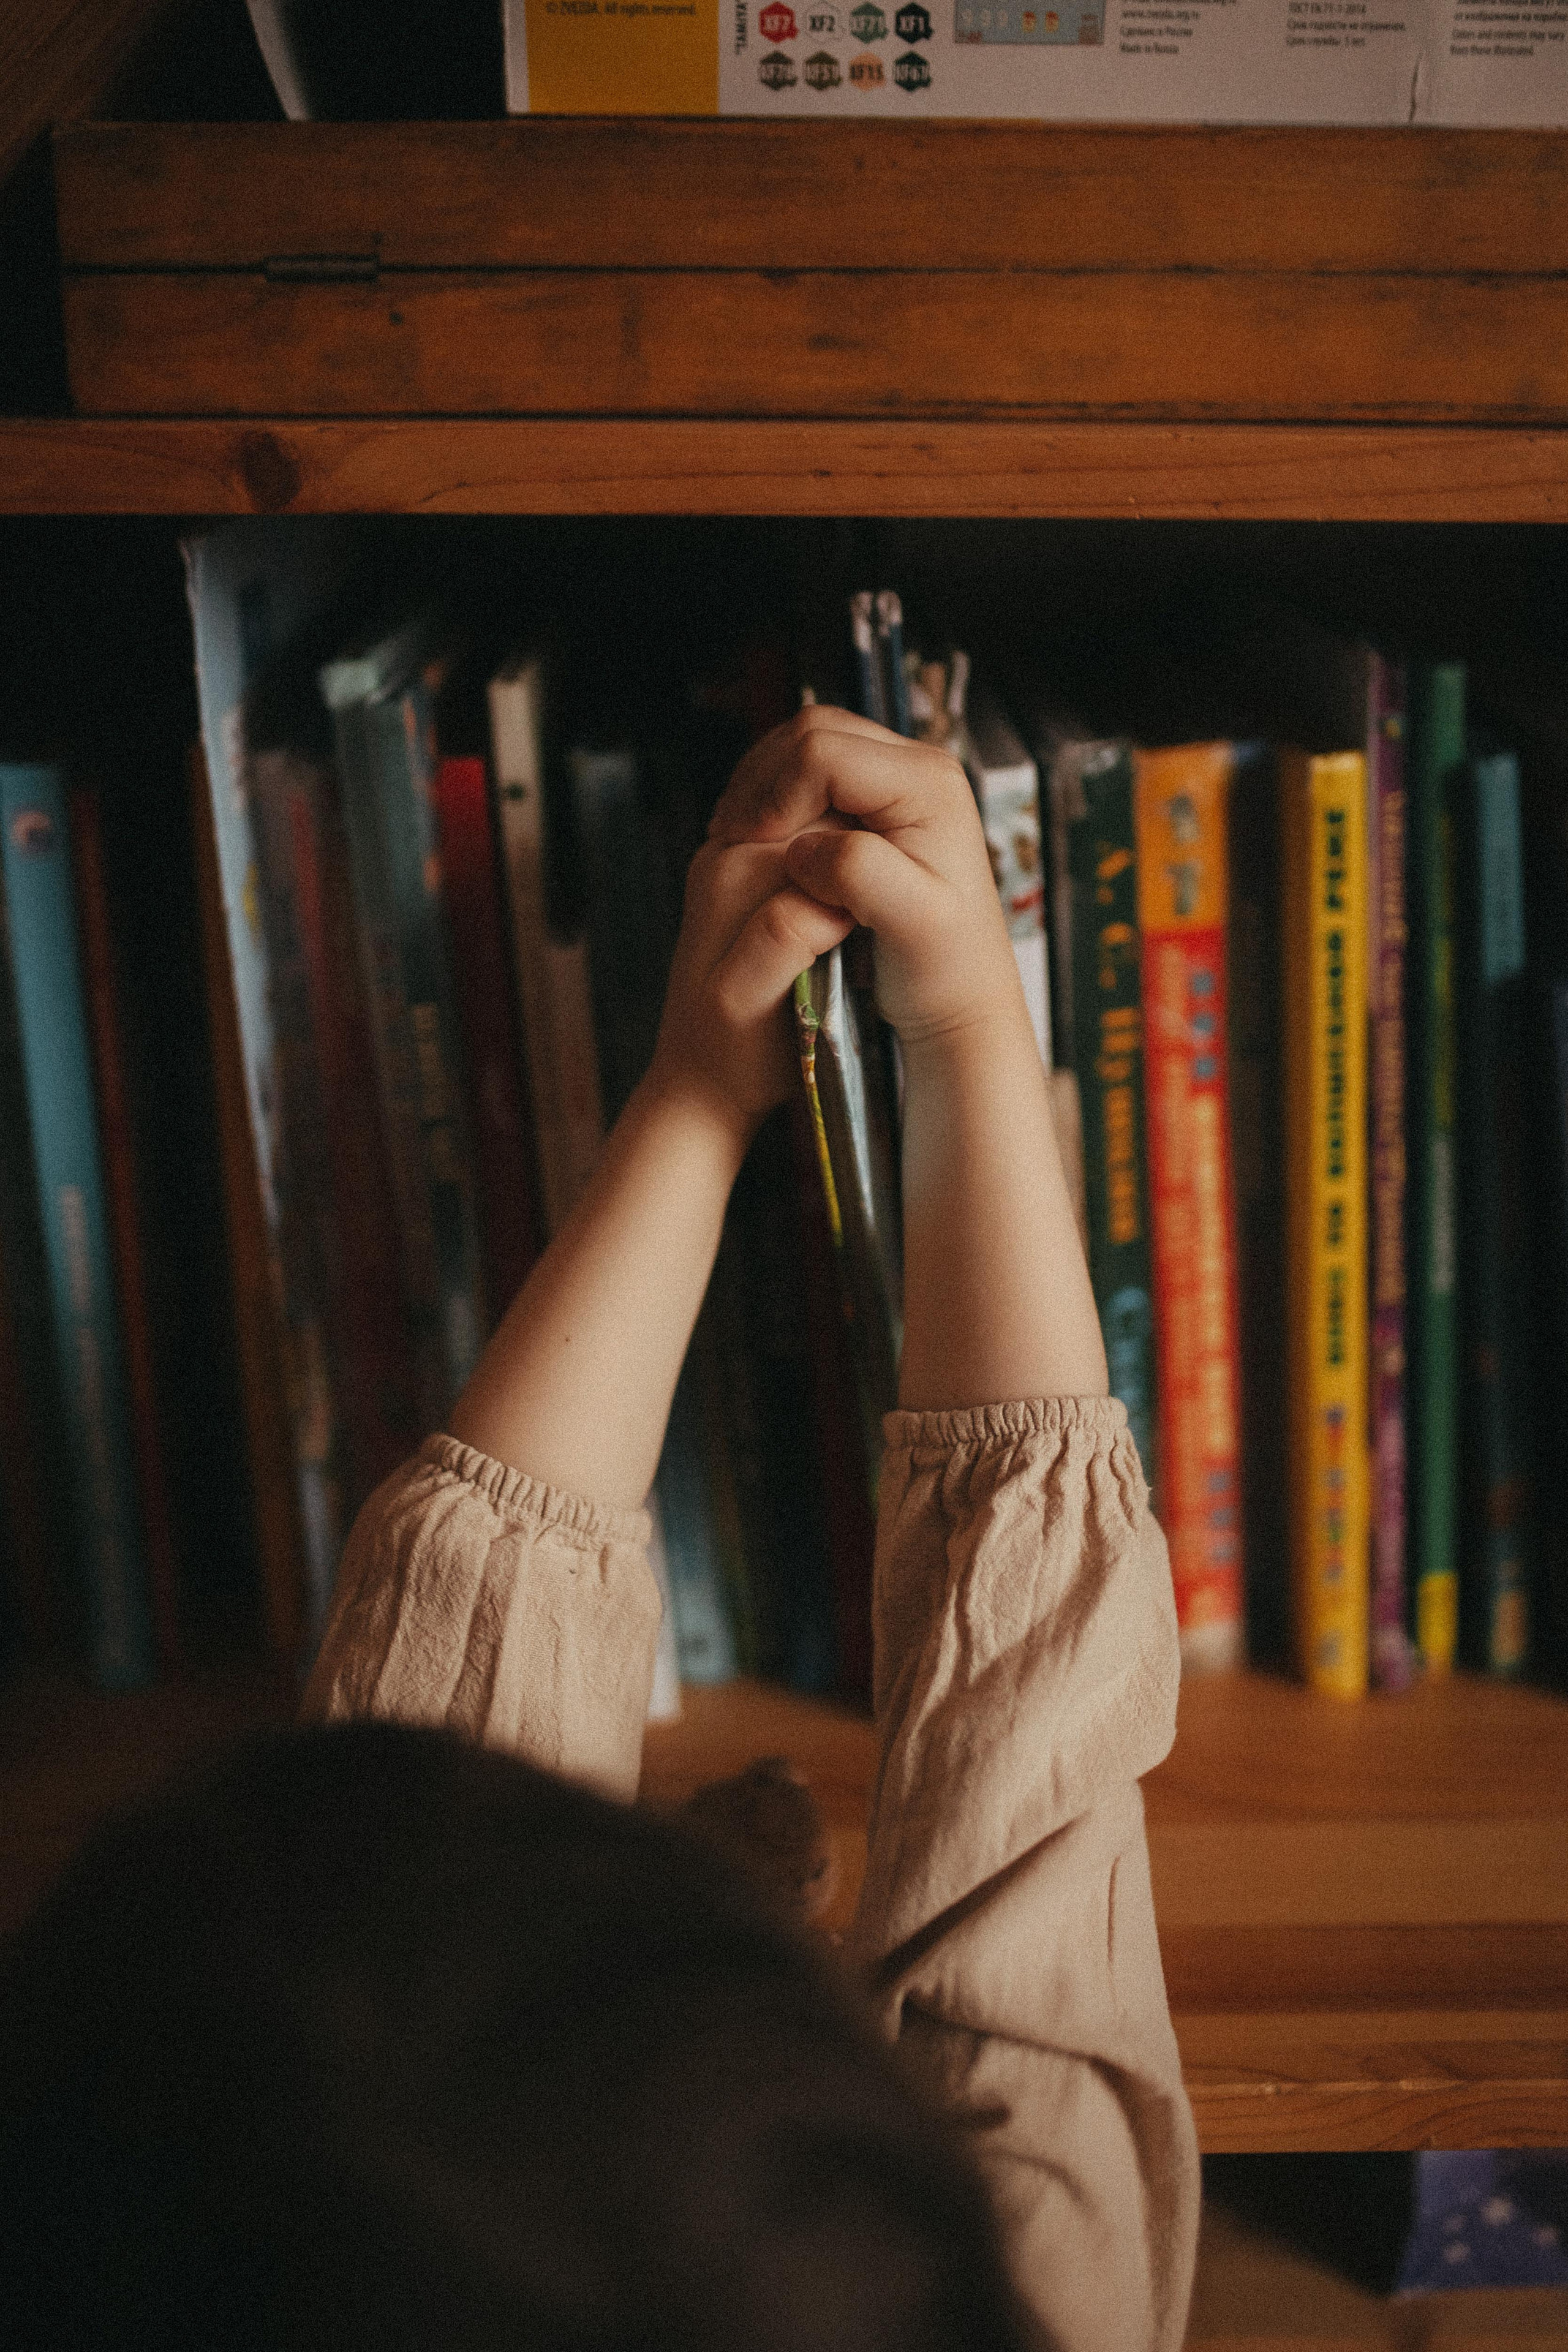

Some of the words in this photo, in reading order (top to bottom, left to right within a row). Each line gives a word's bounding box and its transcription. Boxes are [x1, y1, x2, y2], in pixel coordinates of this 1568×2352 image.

[605, 2, 617, 13] All
[620, 3, 649, 17] rights
[764, 15, 790, 32] XF7
[809, 15, 835, 32] XF2
[900, 15, 925, 32] XF1
[1287, 18, 1307, 30] Срок
[1477, 29, 1492, 39] and
[1529, 31, 1545, 40] may
[1286, 36, 1305, 47] Срок
[1120, 42, 1141, 53] Made
[1144, 44, 1151, 53] in
[1155, 43, 1179, 54] Russia
[1450, 45, 1468, 55] from
[1470, 45, 1491, 55] those
